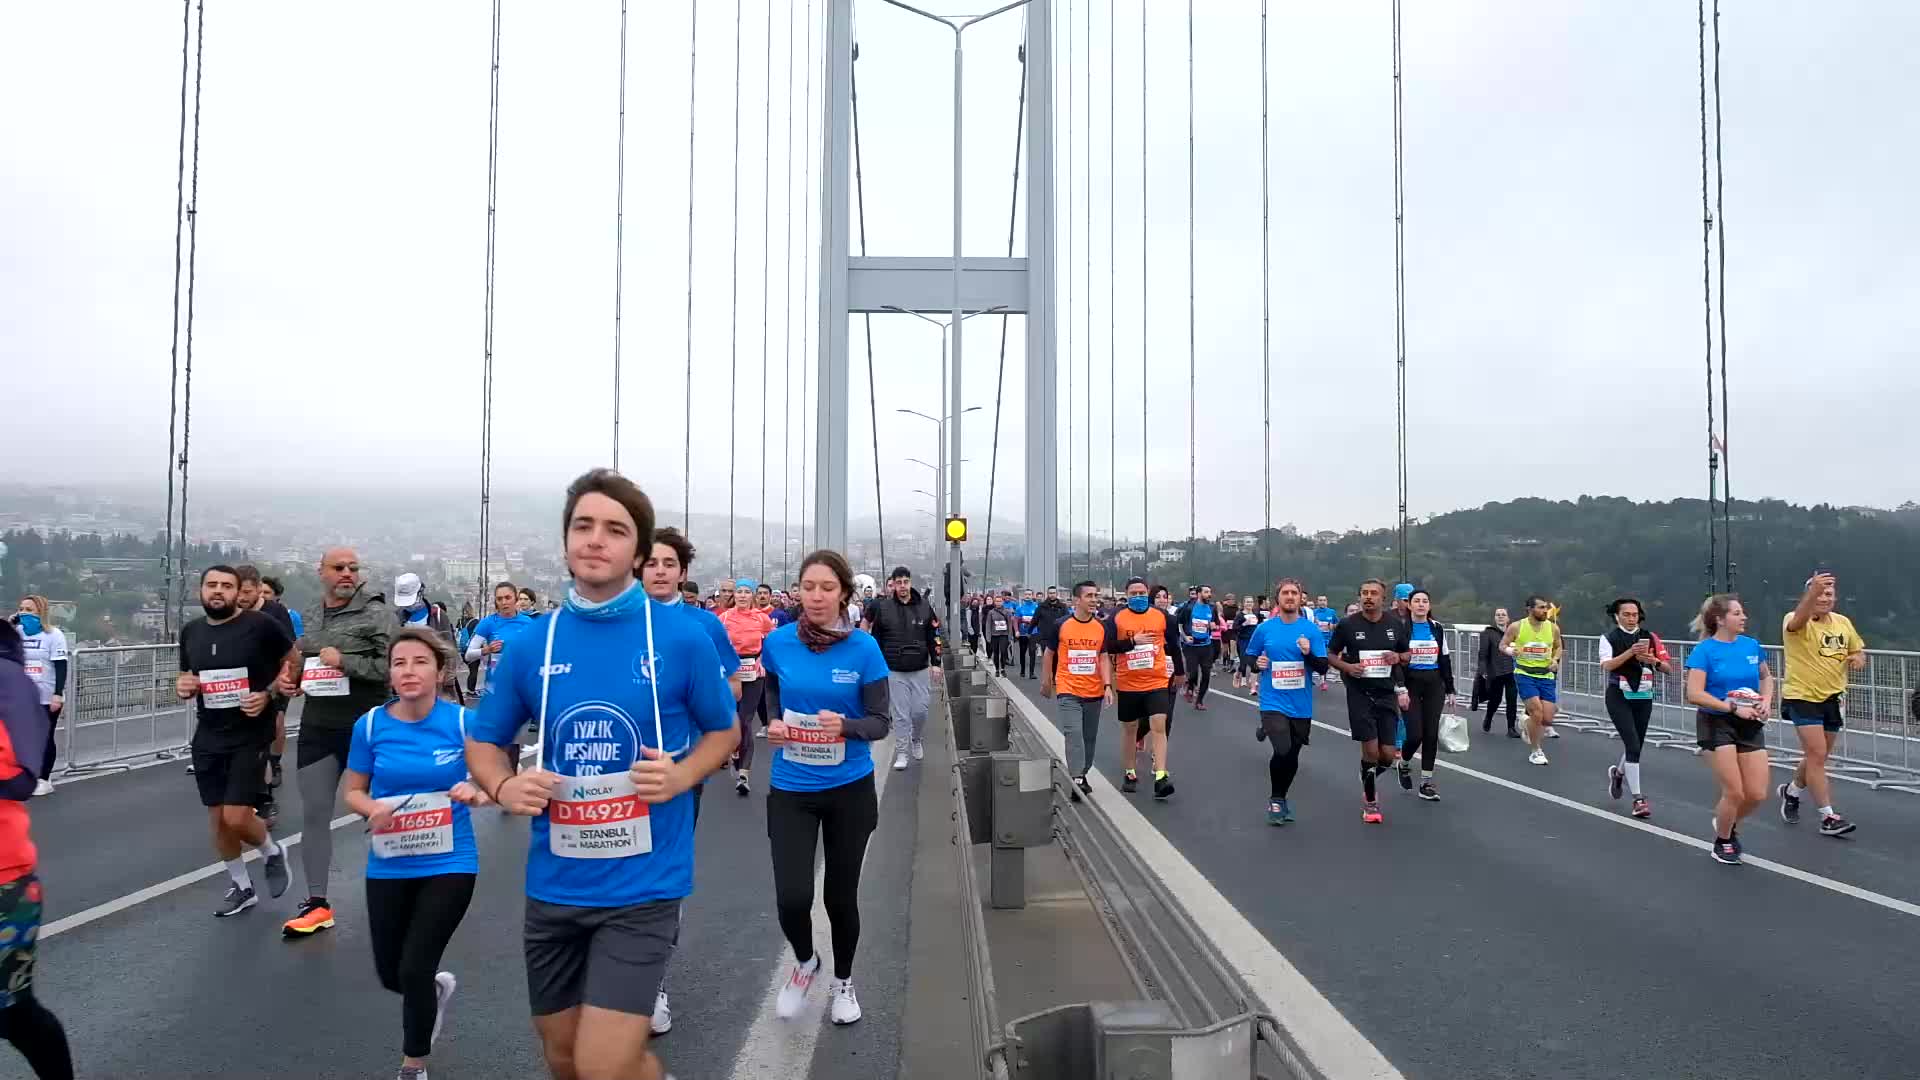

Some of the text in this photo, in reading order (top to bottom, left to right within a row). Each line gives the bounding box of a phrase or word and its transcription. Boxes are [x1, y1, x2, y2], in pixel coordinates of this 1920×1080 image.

[206, 684, 214, 692] A
[790, 728, 799, 738] B
[559, 800, 636, 821] D 14927
[400, 812, 444, 829] 16657
[580, 827, 630, 840] ISTANBUL
[580, 839, 632, 849] MARATHON
